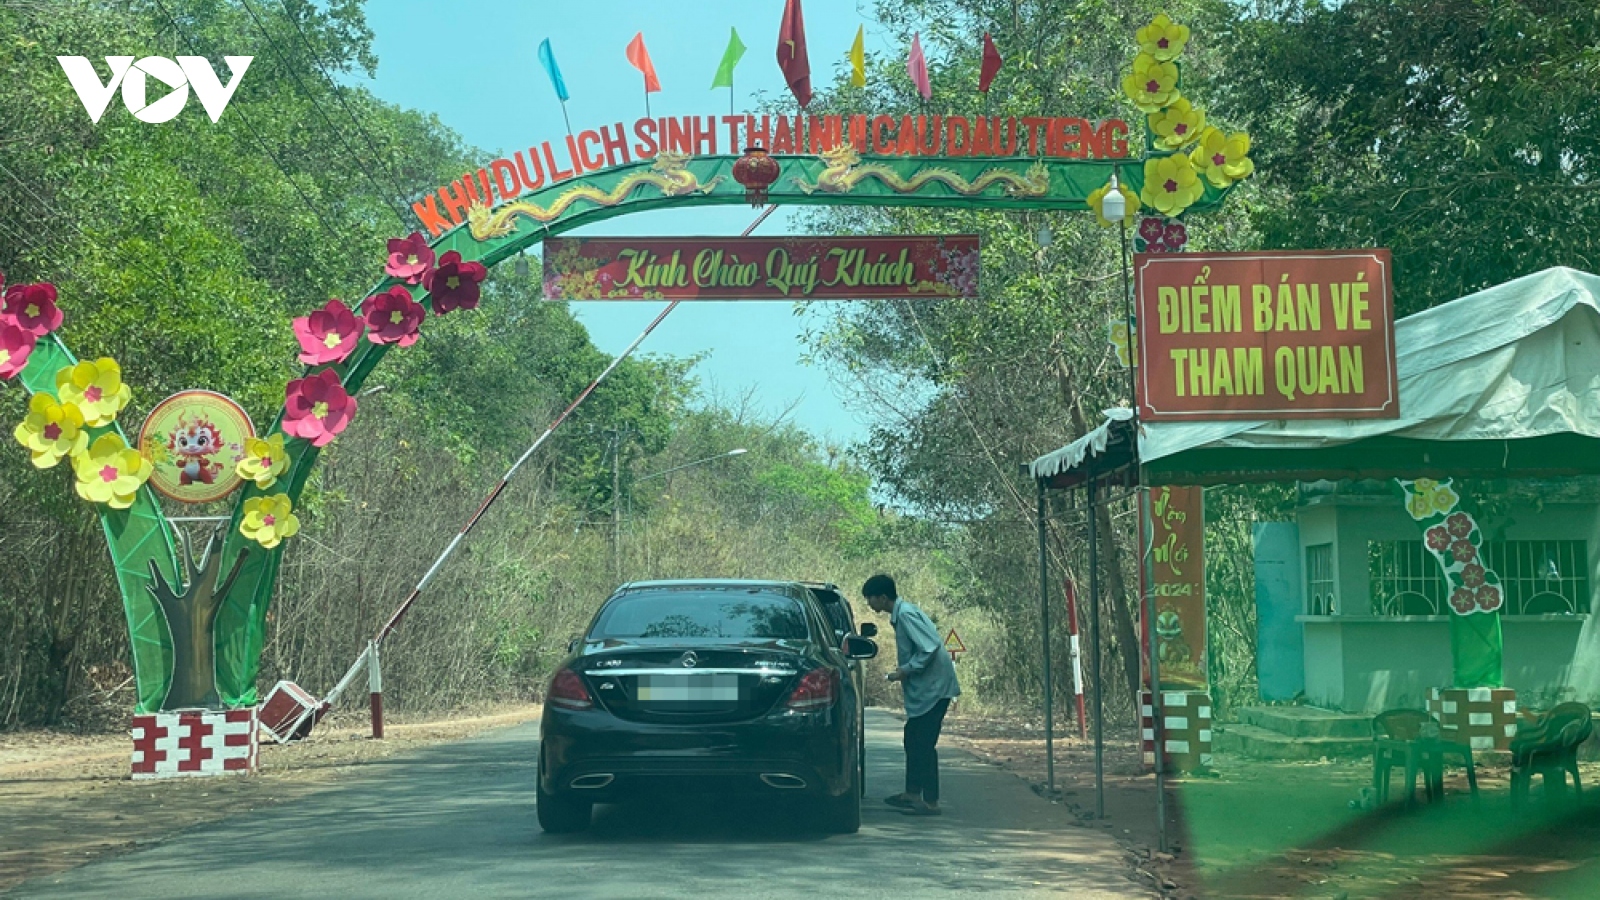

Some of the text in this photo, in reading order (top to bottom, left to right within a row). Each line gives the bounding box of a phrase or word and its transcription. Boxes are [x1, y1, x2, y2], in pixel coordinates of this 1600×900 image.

[412, 168, 494, 238] KHU
[491, 147, 547, 200] DU
[540, 122, 631, 184] LICH
[634, 115, 717, 160] SINH
[722, 115, 803, 155] THAI
[871, 114, 942, 156] CAU
[946, 115, 1017, 157] DAU
[1021, 116, 1129, 159] TIENG
[613, 247, 917, 296] Kính Chào Quý Khách
[1158, 265, 1372, 334] ĐIỂM BÁN VÉ
[1170, 345, 1364, 401] THAM QUAN
[1154, 583, 1192, 597] 2024
